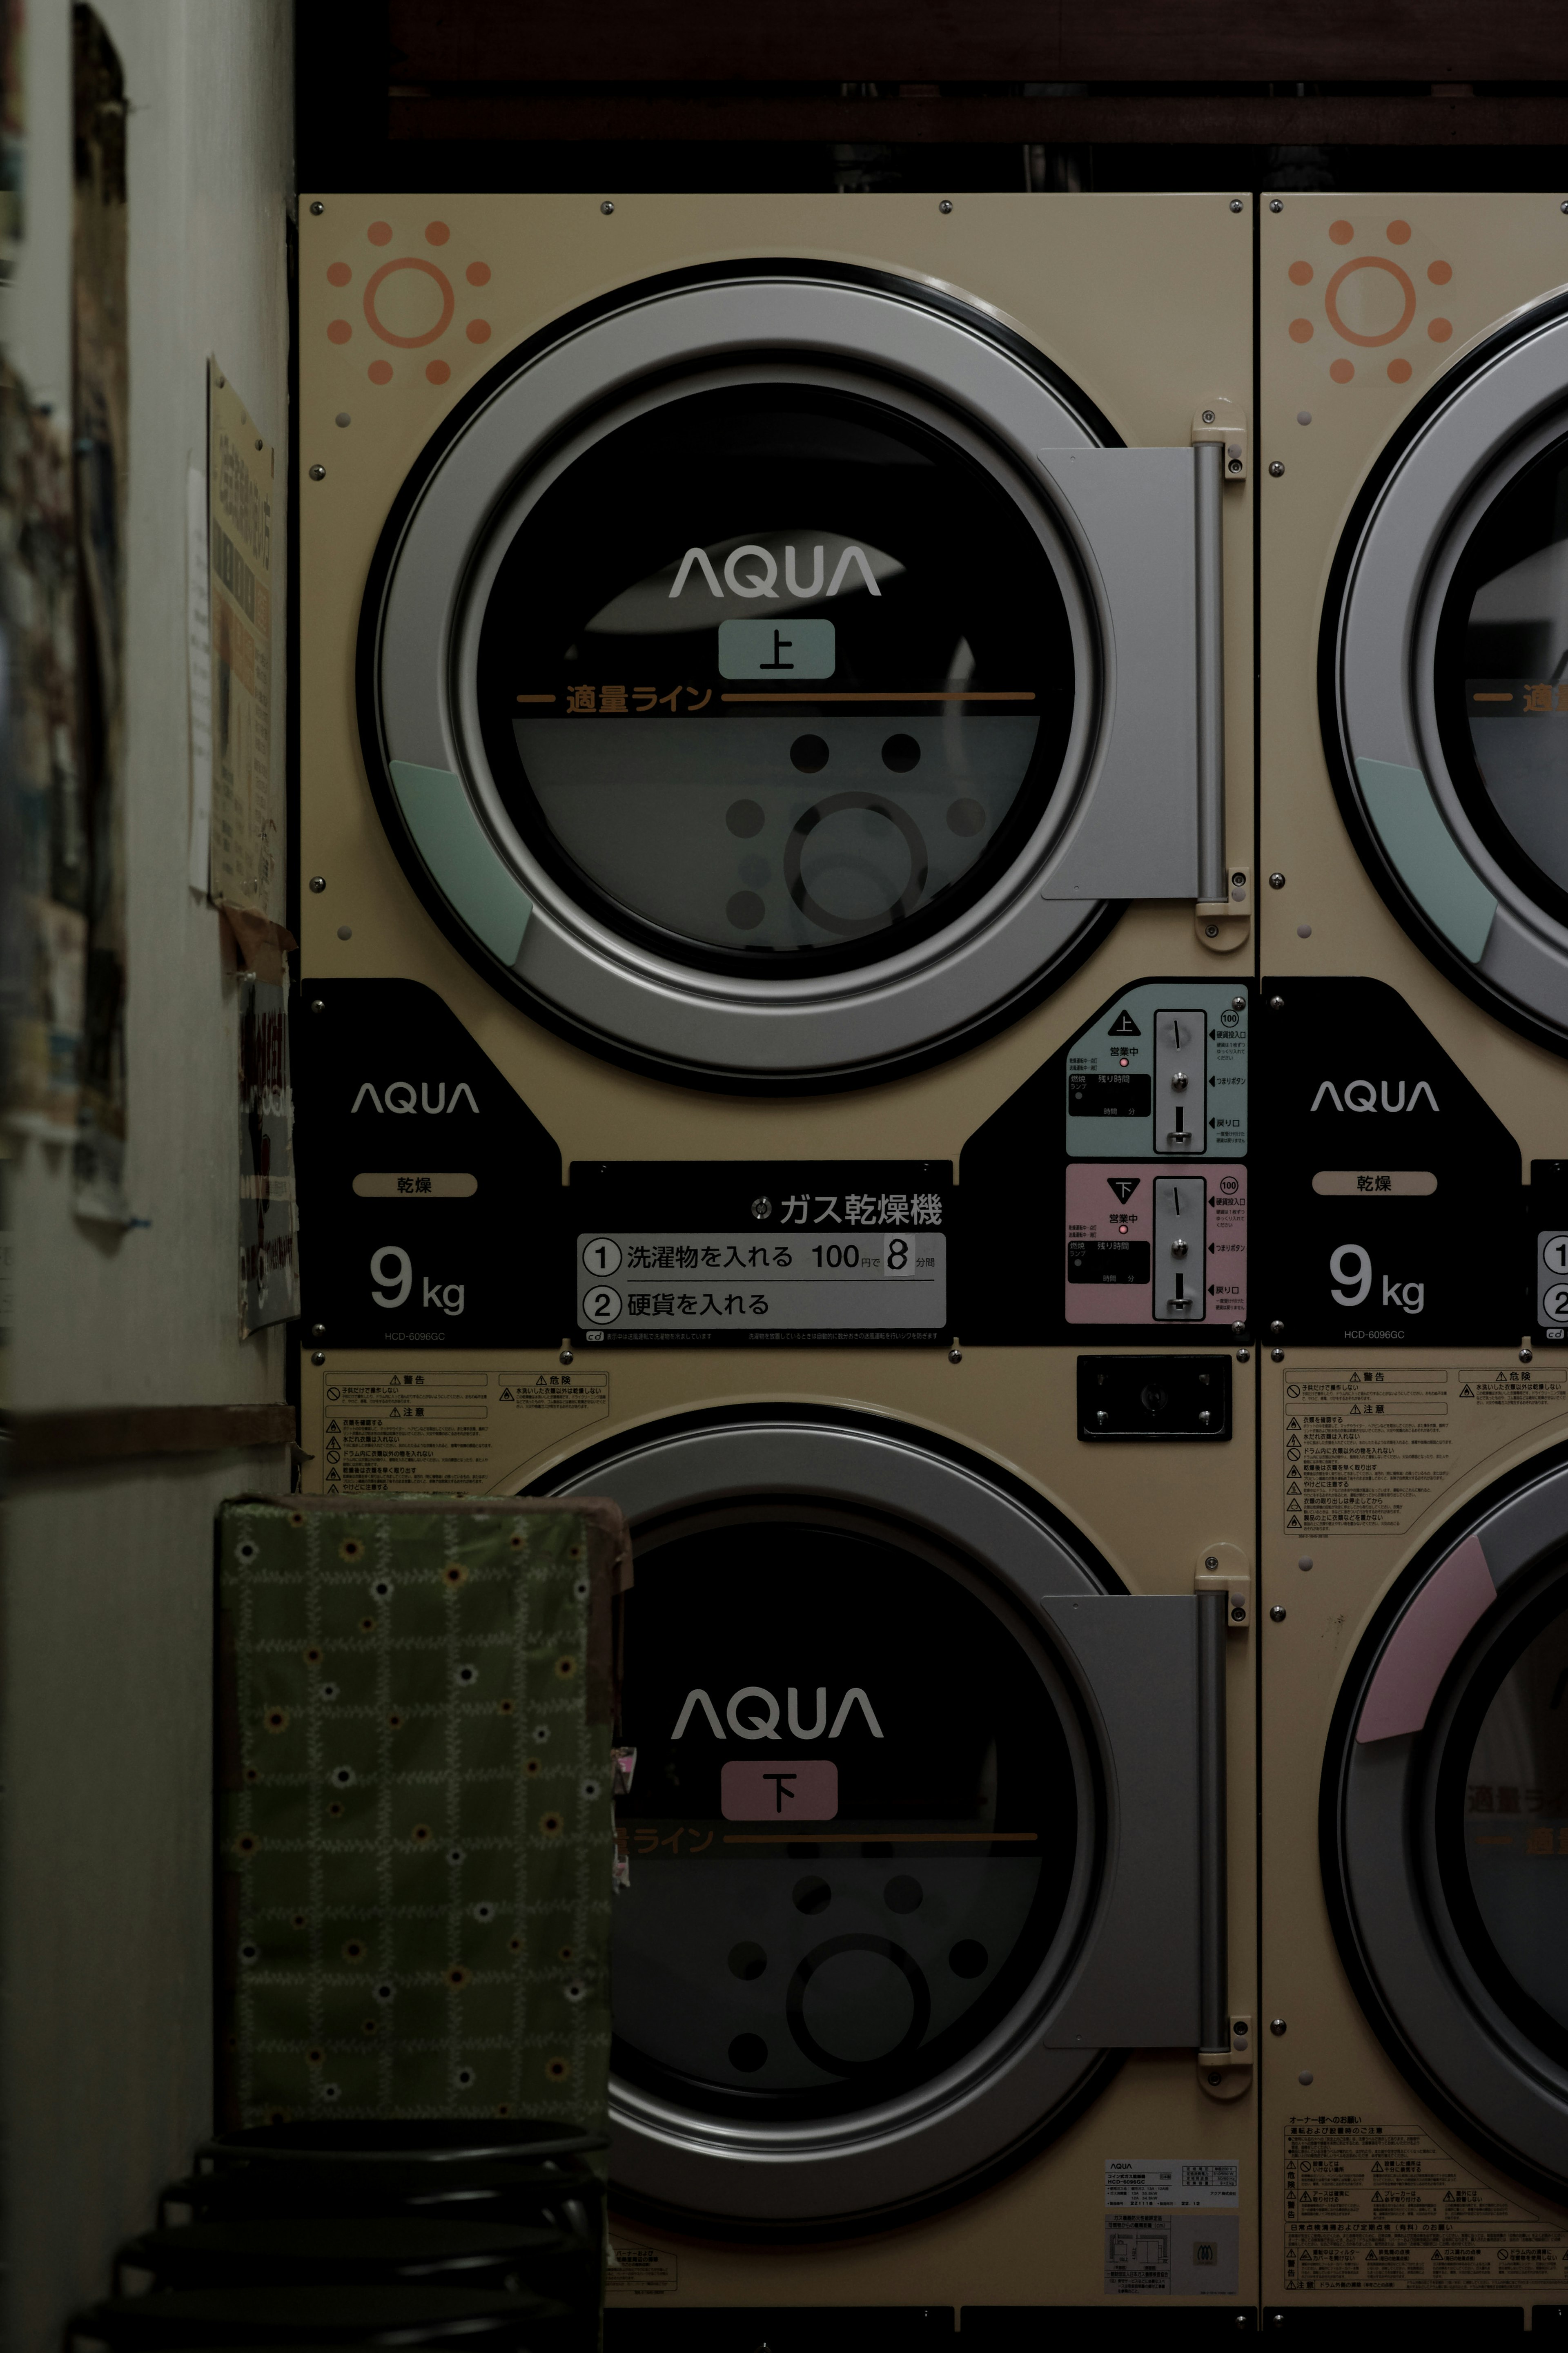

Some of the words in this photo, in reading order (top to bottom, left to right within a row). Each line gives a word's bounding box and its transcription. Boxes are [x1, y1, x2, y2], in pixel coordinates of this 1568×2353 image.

[668, 543, 882, 599] AQUA
[760, 628, 794, 670] 上
[566, 686, 713, 714] 適量ライン
[1116, 1016, 1133, 1032] 上
[1110, 1047, 1138, 1056] 営業中
[1098, 1075, 1130, 1083] 残り時間
[350, 1082, 480, 1114] AQUA
[1310, 1079, 1440, 1113] AQUA
[397, 1177, 432, 1193] 乾燥
[1116, 1182, 1132, 1198] 下
[1357, 1175, 1392, 1192] 乾燥
[780, 1193, 942, 1225] ガス乾燥機
[1109, 1214, 1138, 1223] 営業中
[1097, 1242, 1129, 1250] 残り時間
[627, 1245, 792, 1268] 洗濯物を入れる
[370, 1246, 413, 1309] 9
[423, 1277, 465, 1316] kg
[1330, 1244, 1372, 1307] 9
[1383, 1275, 1424, 1314] kg
[628, 1294, 769, 1317] 硬貨を入れる
[385, 1332, 445, 1341] HCD-6096GC
[1344, 1330, 1405, 1339] HCD-6096GC
[404, 1376, 424, 1385] 警告
[550, 1376, 571, 1385] 危険
[1364, 1372, 1385, 1381] 警告
[1510, 1372, 1531, 1381] 危険
[404, 1408, 424, 1417] 注意
[1364, 1405, 1385, 1414] 注意
[670, 1686, 884, 1739] AQUA
[763, 1774, 797, 1813] 下
[1287, 2171, 1295, 2189] 危険
